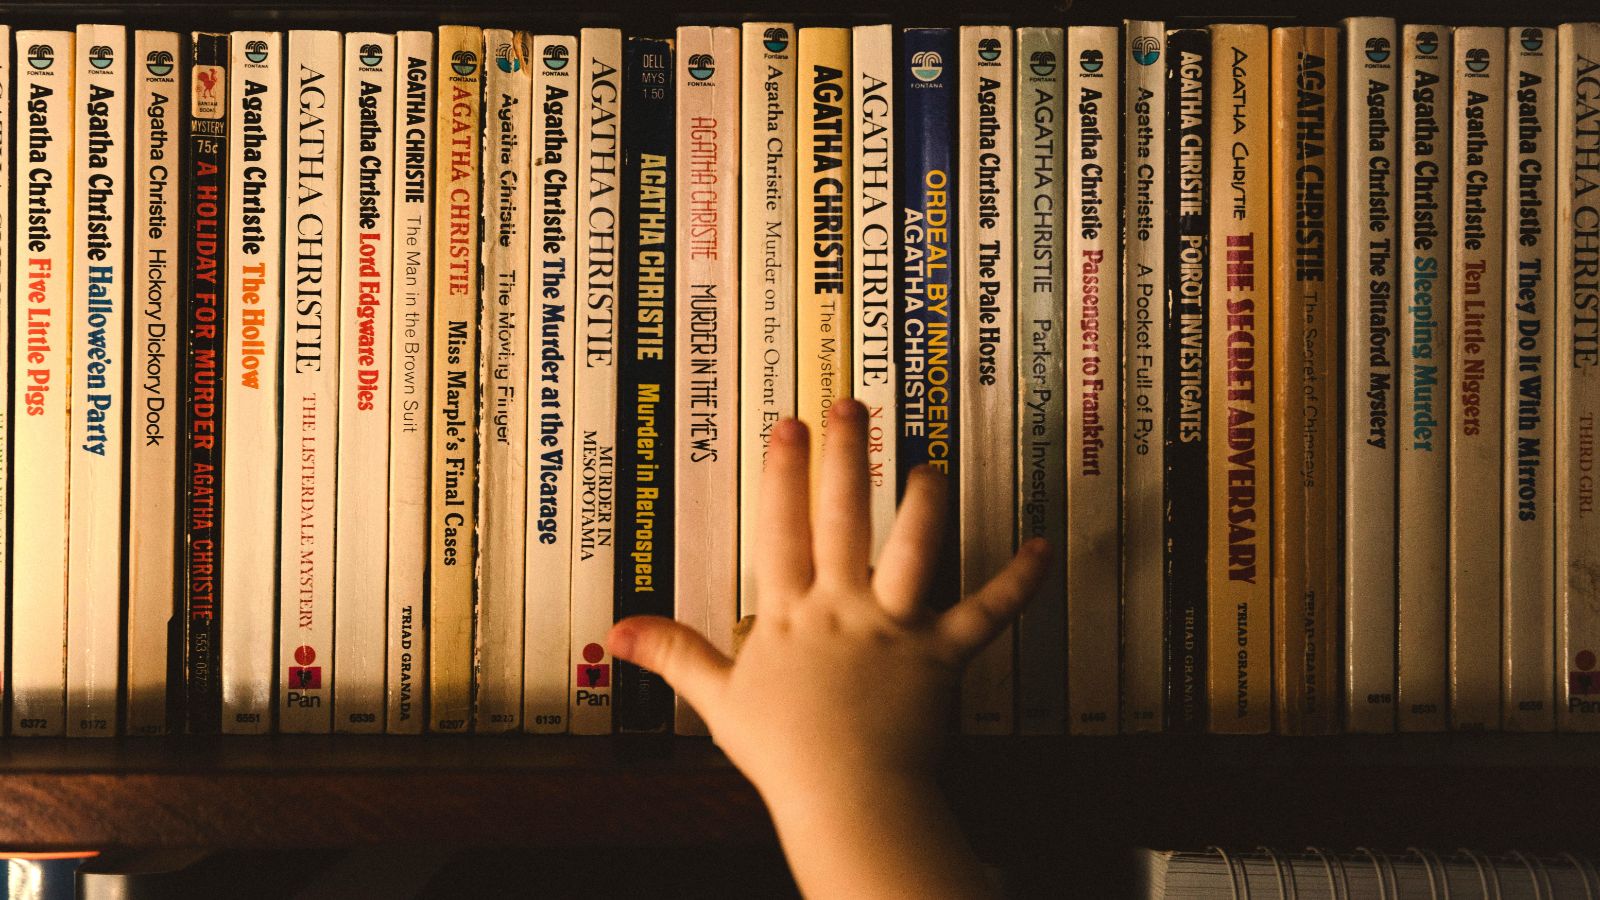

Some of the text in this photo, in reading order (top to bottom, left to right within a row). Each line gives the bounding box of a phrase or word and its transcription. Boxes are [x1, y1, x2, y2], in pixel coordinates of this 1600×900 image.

[191, 120, 225, 134] MYSTERY
[642, 72, 665, 84] MYS
[643, 54, 665, 69] DELL
[766, 66, 782, 131] Agatha
[452, 85, 472, 180] AGATHA
[767, 138, 782, 210] Christie
[1297, 52, 1325, 282] AGATHA CHRISTIE
[26, 84, 53, 416] Agatha Christie Five Little Pigs
[83, 84, 114, 456] Agatha Christie Hallowe'en Party
[144, 92, 168, 446] Agatha Christie Hickory Dickory Dock
[296, 64, 325, 373] AGATHA CHRISTIE
[403, 57, 426, 432] AGATHA CHRISTIE The Man in the Brown Suit
[450, 188, 469, 295] CHRISTIE
[587, 57, 617, 368] AGATHA CHRISTIE
[764, 221, 780, 284] Murder
[813, 65, 843, 428] AGATHA CHRISTIE The Mysterious
[862, 72, 889, 386] AGATHA CHRISTIE
[926, 170, 948, 277] ORDEAL
[1027, 89, 1052, 435] AGATHA CHRISTIE Parker Pyne
[1179, 52, 1202, 443] AGATHA CHRISTIE POIROT INVESTIGATES
[1574, 54, 1600, 368] AGATHA CHRISTIE
[242, 263, 265, 389] The Hollow
[357, 233, 380, 410] Lord Edgware Dies
[448, 321, 467, 364] Miss
[691, 117, 718, 462] AGATHA CHRISTIE MURDER IN THE MEWS
[764, 317, 779, 343] the
[765, 290, 776, 310] on
[903, 208, 925, 437] AGATHA CHRISTIE
[927, 283, 947, 316] BY
[980, 241, 999, 385] The Pale Horse
[1227, 47, 1256, 584] AGATHA CHRISTIE THE SECRET ADVERSARY
[1366, 238, 1390, 449] The Sittaford Mystery
[1409, 256, 1438, 451] Sleeping Murder
[1462, 260, 1486, 436] Ten Little Niggers
[192, 161, 218, 620] A HOLIDAY FOR MURDER AGATHA CHRISTIE
[538, 258, 566, 545] The Murder at the Vicarage
[631, 153, 666, 592] AGATHA CHRISTIE Murder in Retrospect
[763, 349, 779, 405] Orient
[1080, 250, 1103, 476] Passenger to Frankfurt
[1134, 264, 1153, 455] A Pocket Full of Rye
[1516, 259, 1541, 521] They Do It With Mirrors
[299, 393, 317, 631] THE LISTERDALE MYSTERY
[446, 458, 464, 505] Final
[581, 430, 597, 561] MESOPOTAMIA
[598, 446, 612, 546] MURDER IN
[869, 406, 883, 487] N OR M?
[1579, 412, 1593, 519] THIRD GIRL
[444, 512, 464, 566] Cases
[21, 719, 48, 729] 6372
[80, 720, 107, 729] 6172
[287, 692, 321, 708] Pan
[400, 606, 412, 721] TRIAD GRANADA
[535, 715, 561, 725] 6130
[576, 690, 610, 706] Pan
[1238, 603, 1248, 717] TRIAD GRANADA
